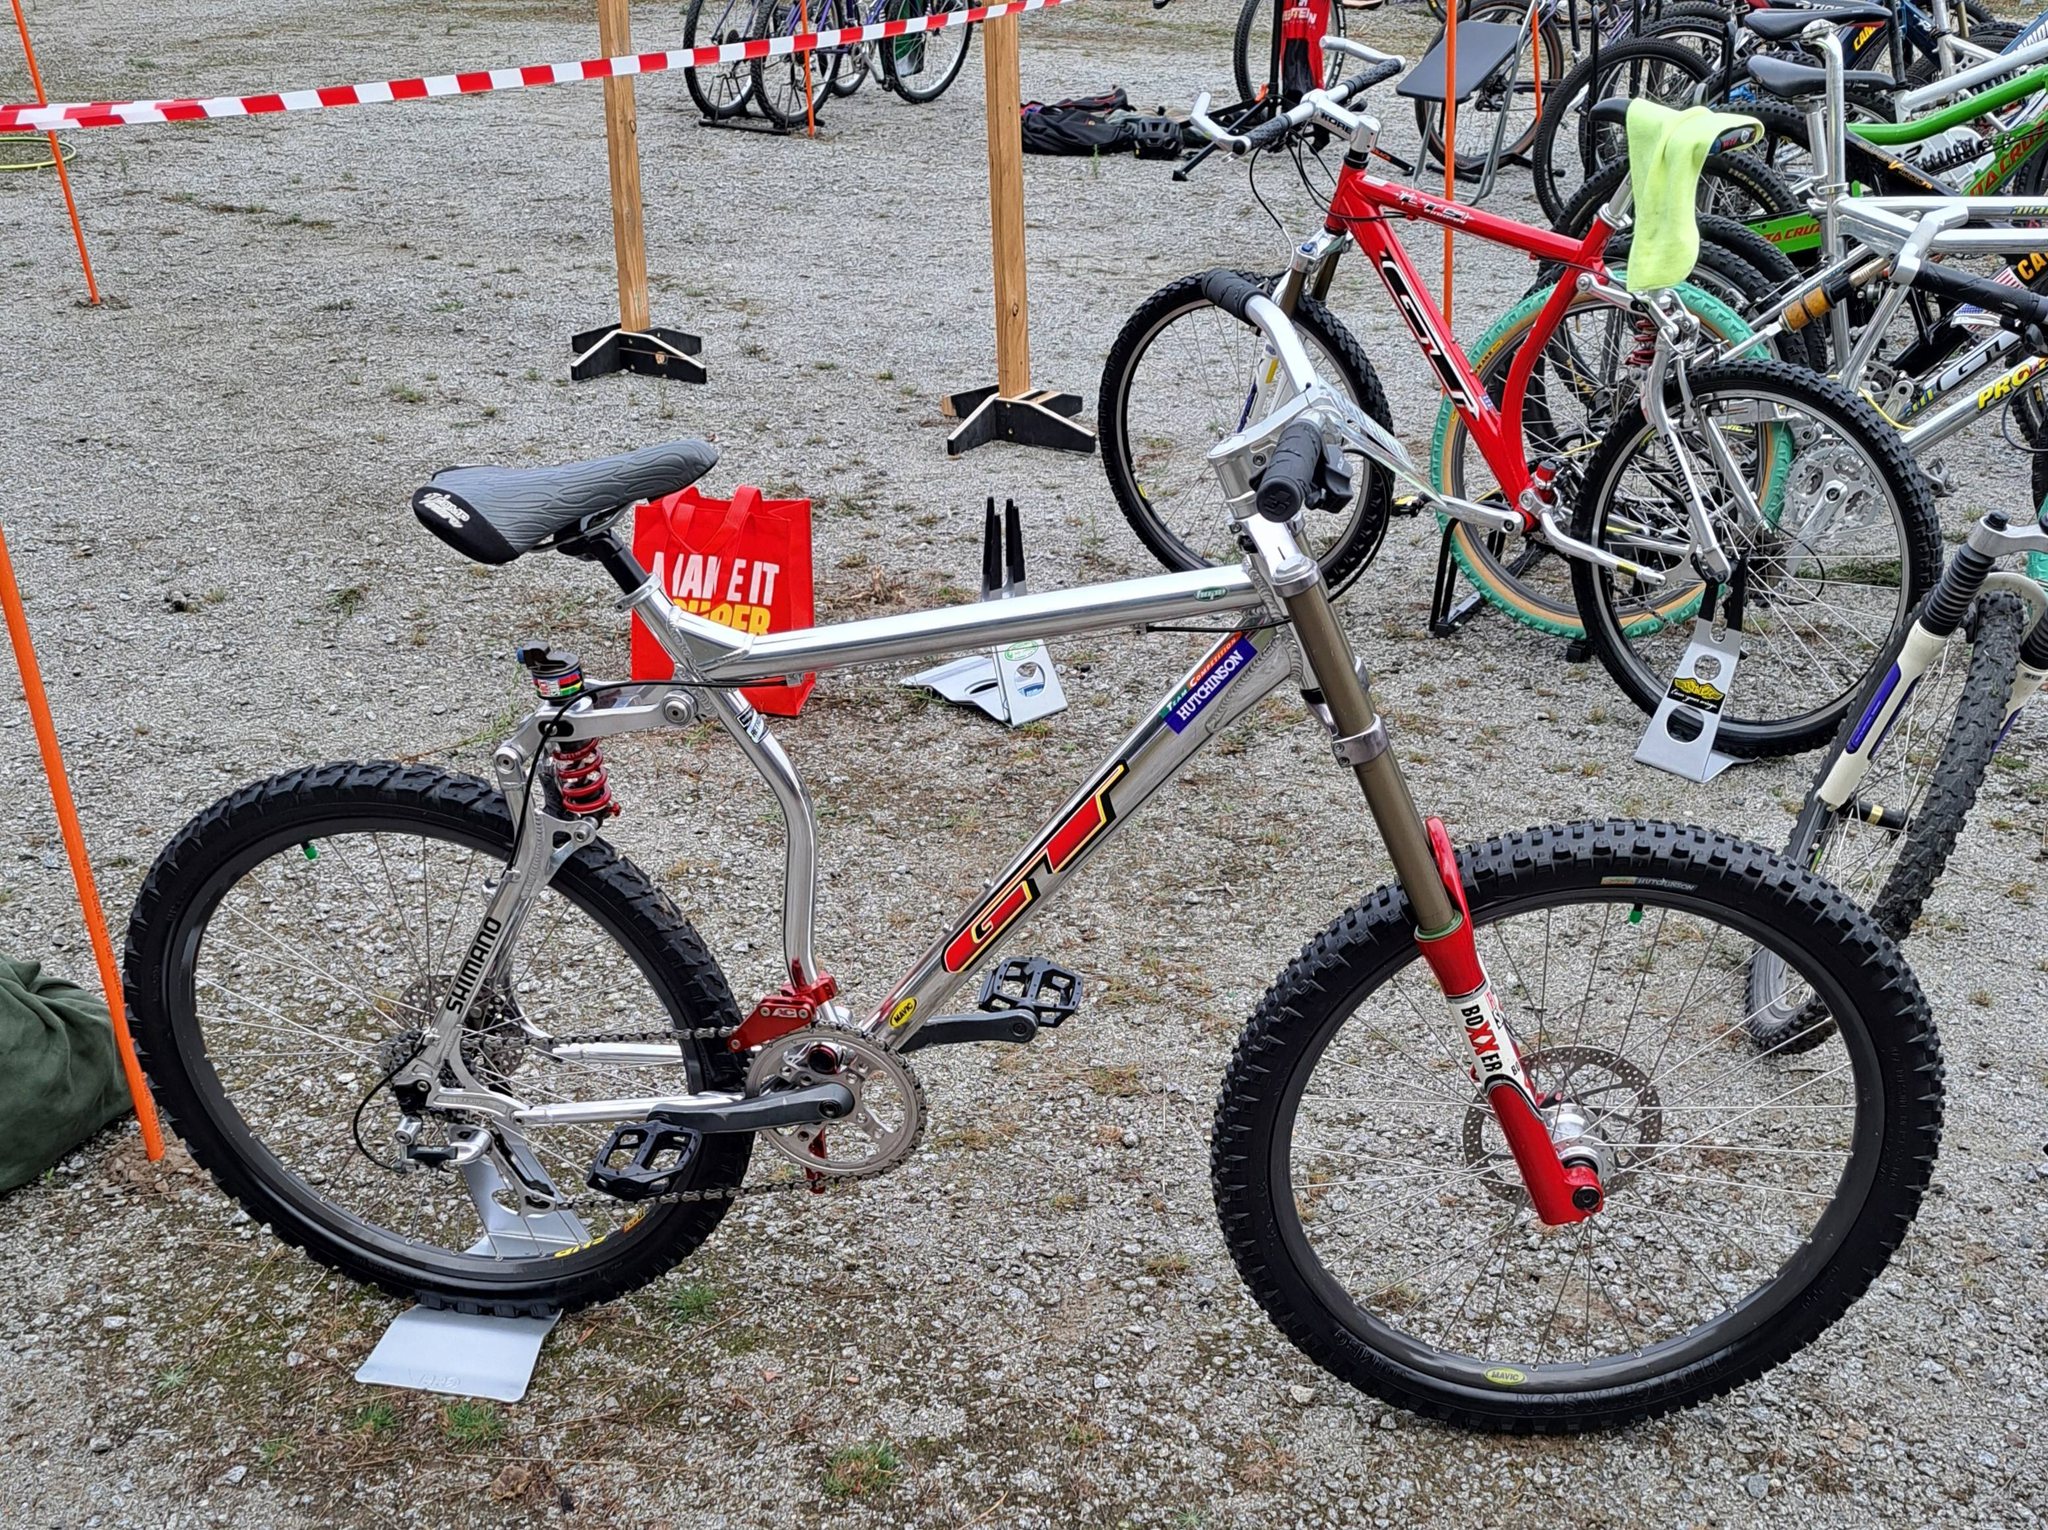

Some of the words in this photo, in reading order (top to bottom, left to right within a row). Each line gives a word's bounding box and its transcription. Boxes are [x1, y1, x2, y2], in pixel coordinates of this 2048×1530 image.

[1320, 112, 1353, 137] KORE
[1662, 433, 1695, 504] SHIMANO
[748, 560, 780, 606] IT
[1175, 649, 1244, 721] HUTCHINSON
[1189, 638, 1236, 688] COMPETITION
[941, 764, 1130, 973] GT
[1637, 877, 1696, 891] HUTCHINSON
[445, 916, 502, 1015] SHIMANO
[893, 1001, 914, 1024] MAVIC
[1460, 1003, 1503, 1073] BOXXER
[1491, 1369, 1520, 1382] MAVIC
